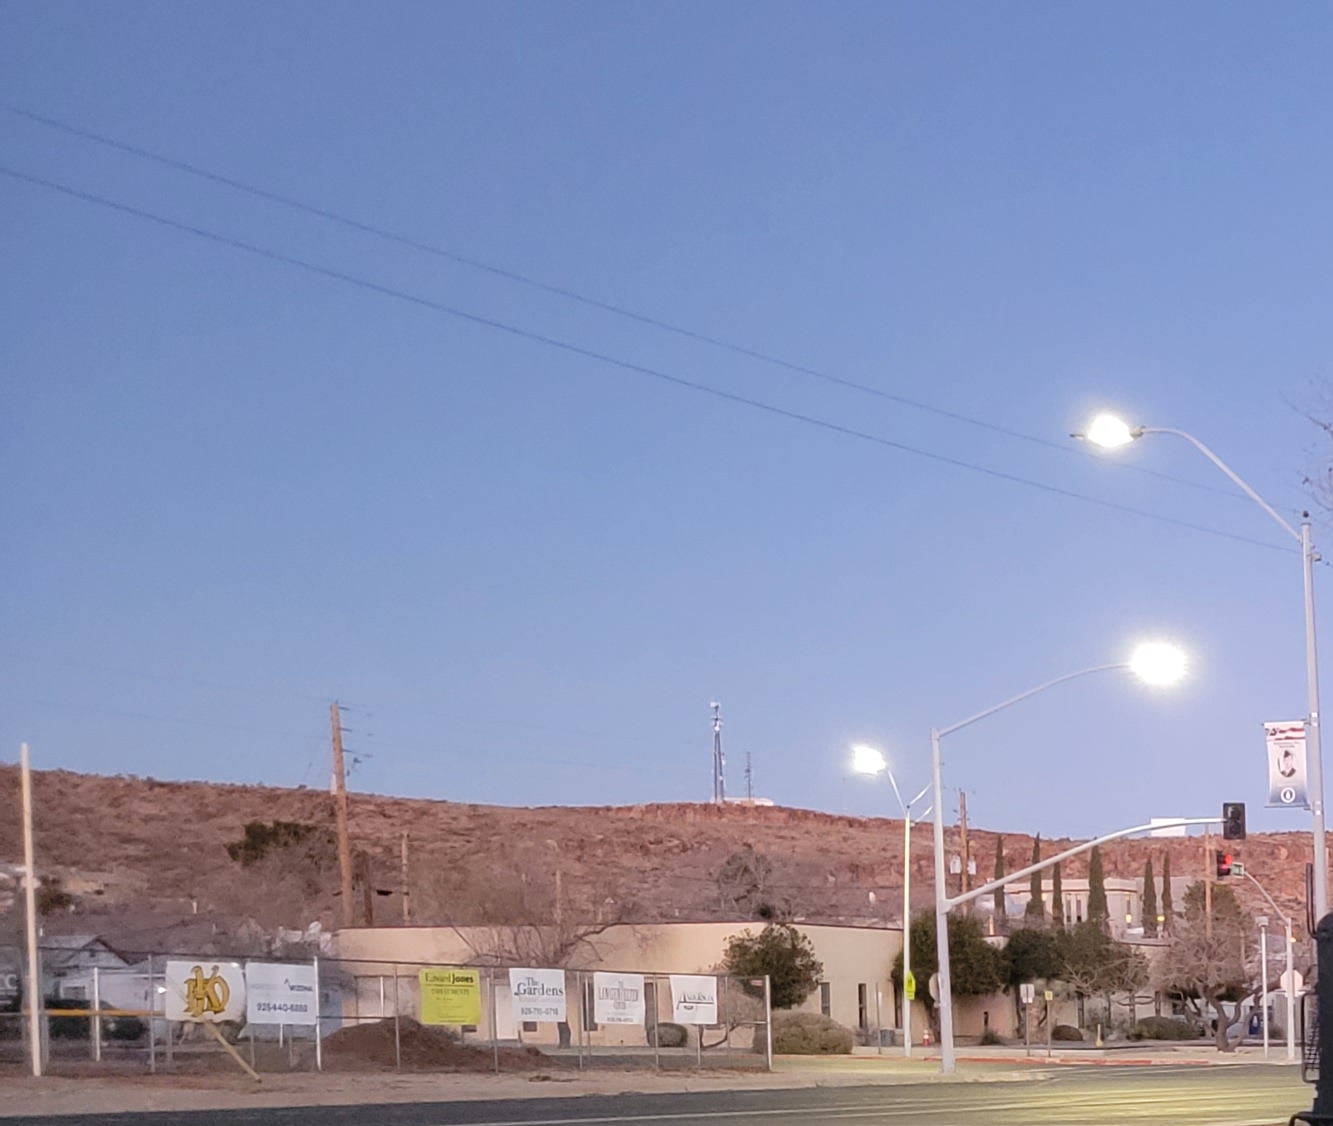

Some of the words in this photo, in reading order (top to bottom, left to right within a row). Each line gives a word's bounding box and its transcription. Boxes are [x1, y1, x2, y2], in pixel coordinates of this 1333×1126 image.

[451, 973, 474, 984] Jones
[525, 976, 540, 987] The
[516, 982, 564, 997] Gardens
